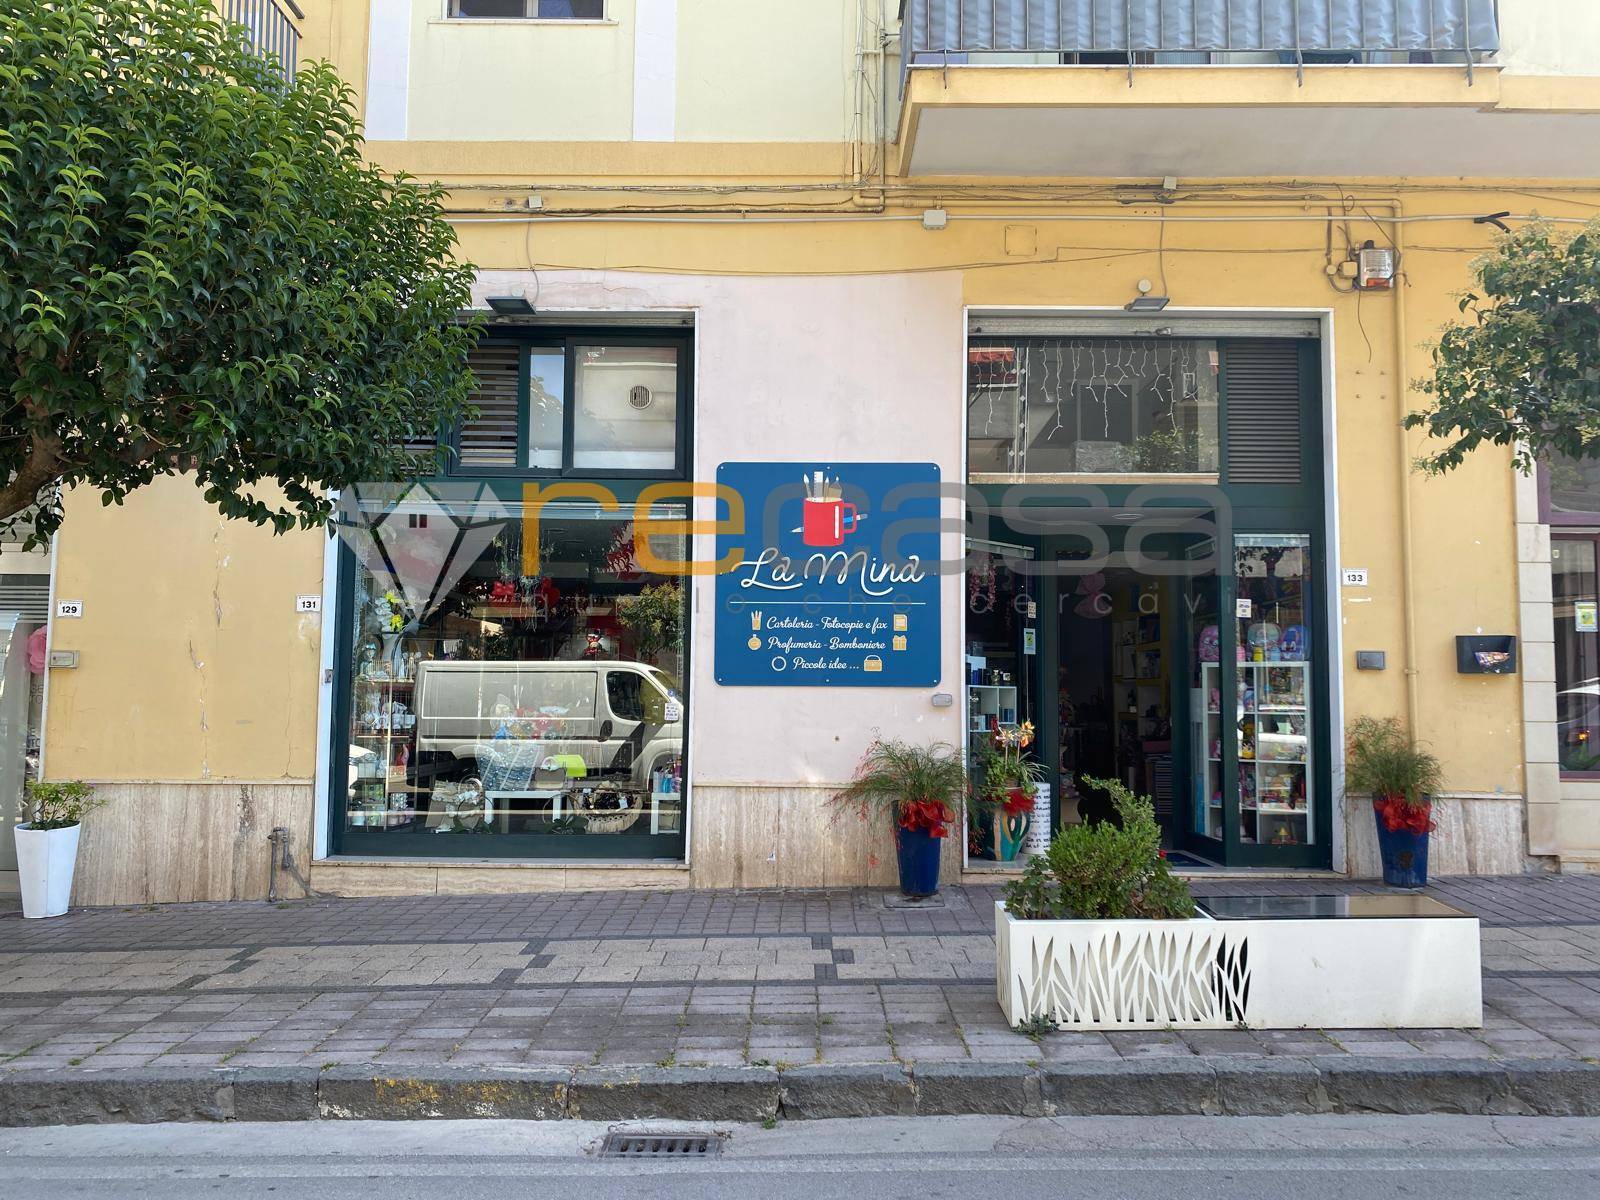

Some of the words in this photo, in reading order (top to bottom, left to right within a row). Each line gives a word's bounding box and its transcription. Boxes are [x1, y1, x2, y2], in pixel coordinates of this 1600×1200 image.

[731, 547, 803, 589] La
[803, 551, 926, 596] Mina
[1347, 574, 1363, 582] 133
[61, 605, 78, 614] 129
[301, 600, 317, 609] 131
[766, 616, 814, 630] Cartoleria
[820, 616, 864, 634] Fotocopie
[871, 617, 889, 634] fax
[767, 636, 822, 654] Profumeria
[829, 636, 886, 650] Bomboniere
[792, 656, 828, 670] Piccole
[828, 657, 848, 670] idee
